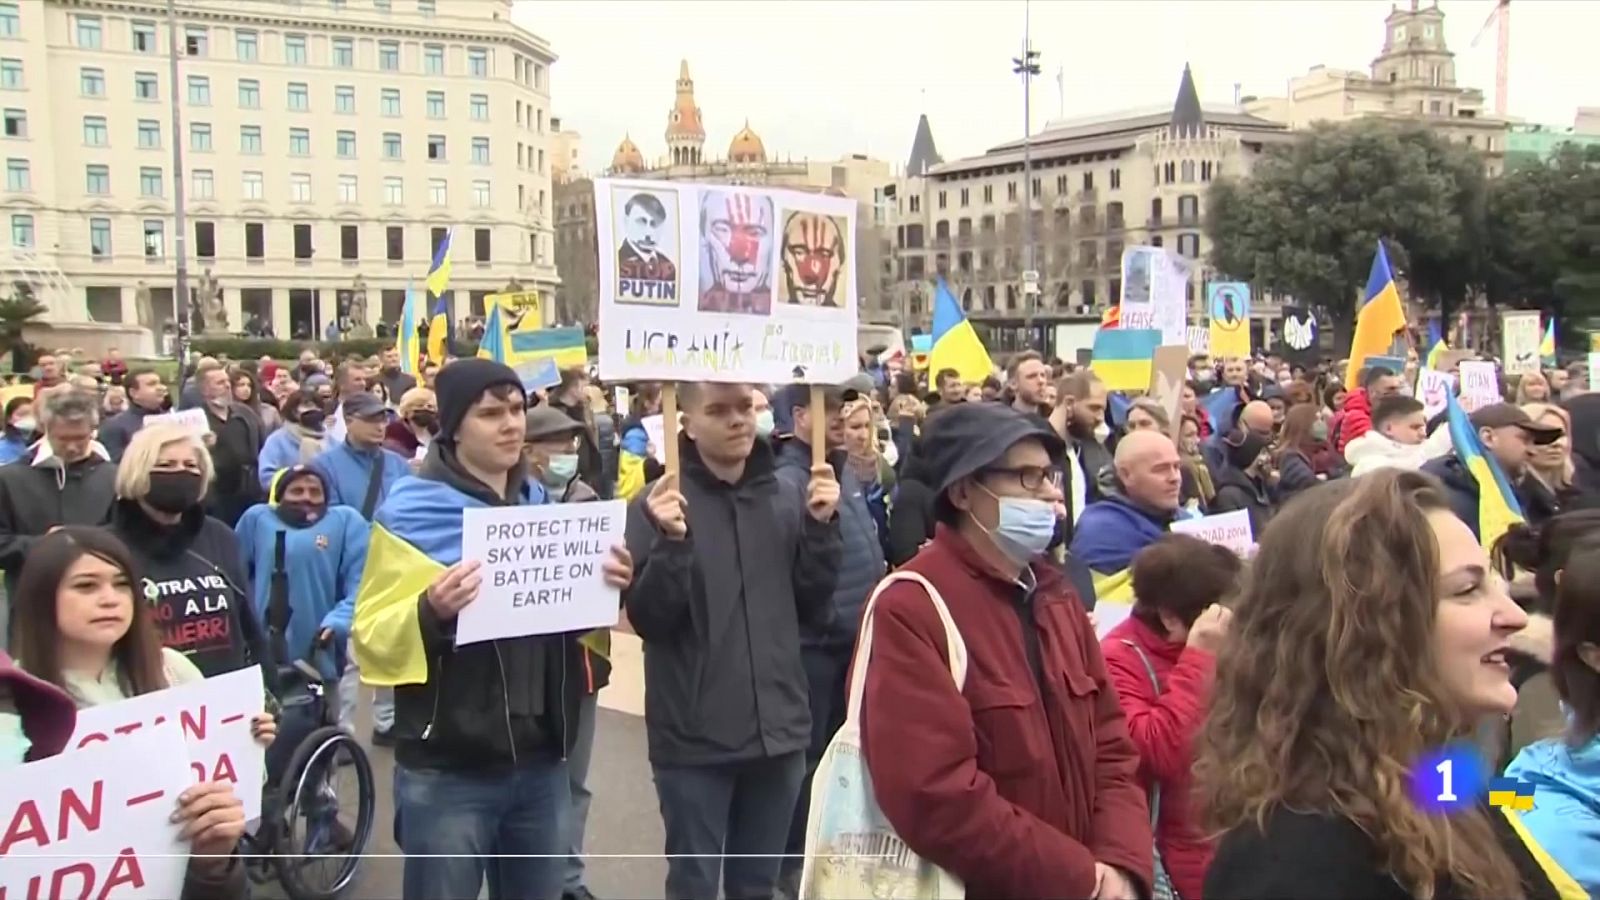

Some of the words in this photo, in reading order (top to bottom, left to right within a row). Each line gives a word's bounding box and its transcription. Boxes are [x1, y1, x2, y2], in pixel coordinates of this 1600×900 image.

[618, 280, 675, 300] PUTIN
[486, 519, 572, 541] PROTECT
[578, 516, 611, 534] THE
[486, 545, 525, 564] SKY
[530, 542, 558, 560] WE
[563, 540, 604, 556] WILL
[494, 564, 565, 587] BATTLE
[569, 562, 593, 578] ON
[184, 598, 201, 616] A
[204, 594, 228, 612] LA
[512, 587, 573, 608] EARTH
[162, 616, 229, 645] UERR
